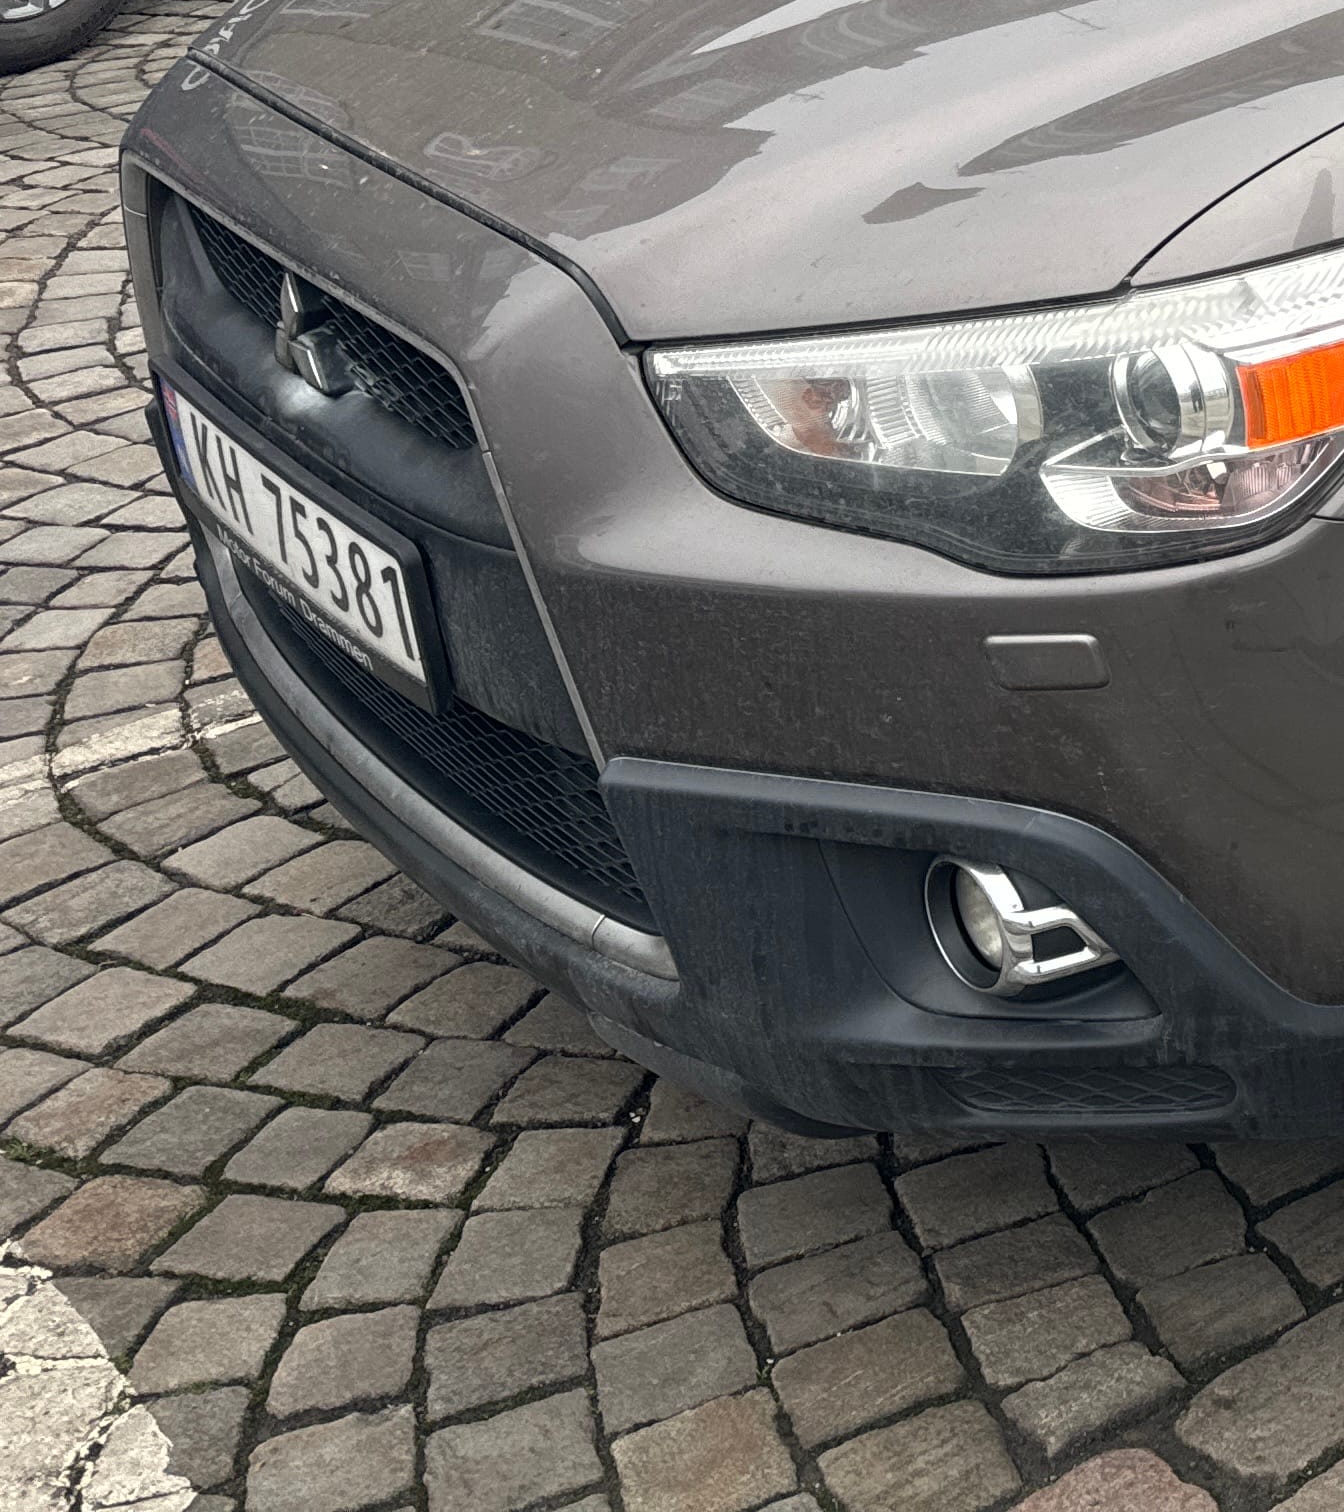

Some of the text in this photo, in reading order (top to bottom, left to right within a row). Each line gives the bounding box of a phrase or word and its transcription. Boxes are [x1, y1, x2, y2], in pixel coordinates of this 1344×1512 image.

[190, 412, 415, 661] KH 75381
[216, 524, 374, 672] Motor Forum Drammen
